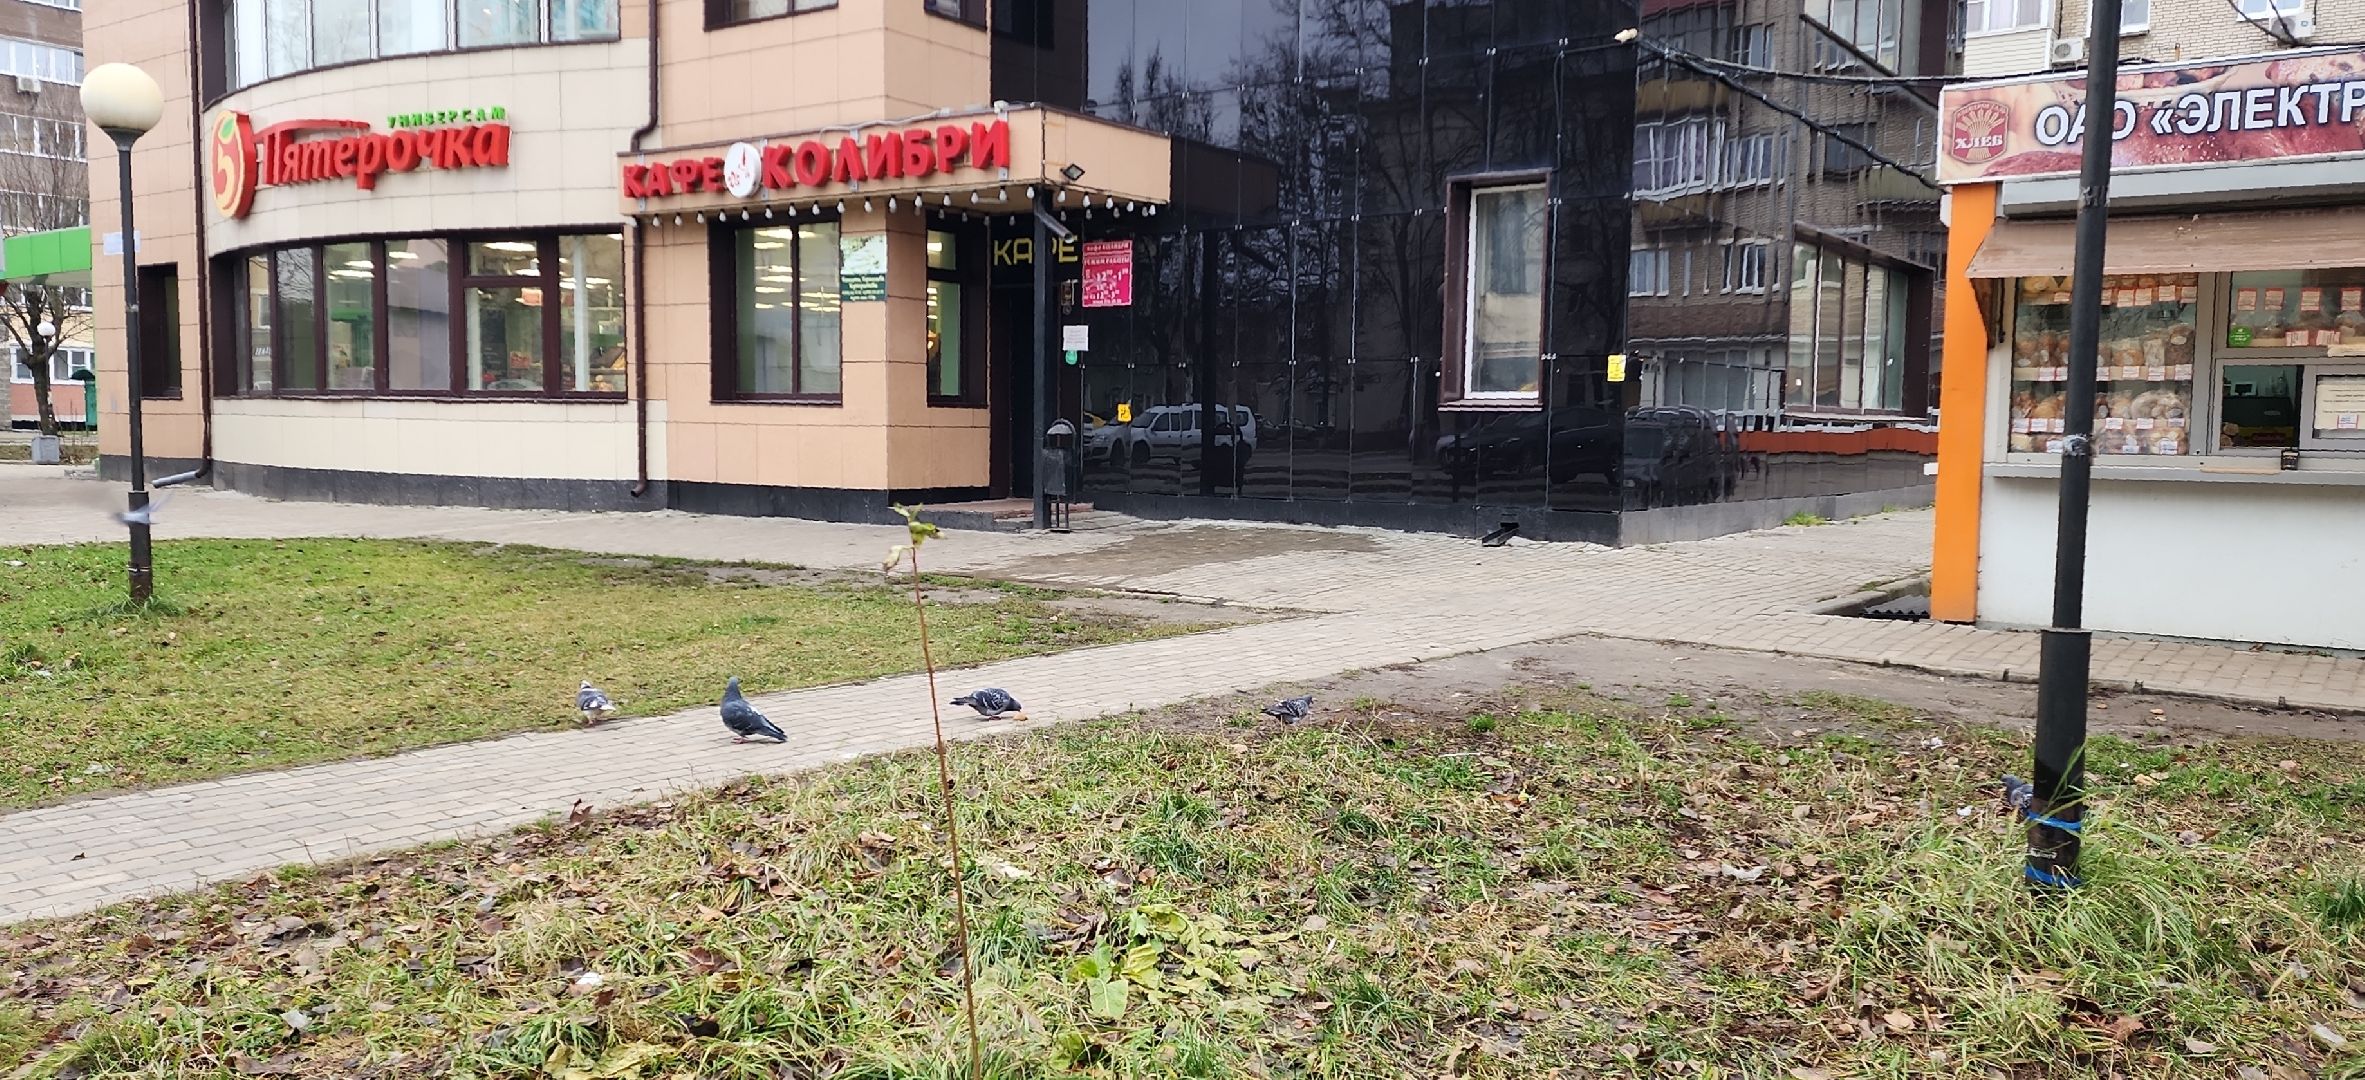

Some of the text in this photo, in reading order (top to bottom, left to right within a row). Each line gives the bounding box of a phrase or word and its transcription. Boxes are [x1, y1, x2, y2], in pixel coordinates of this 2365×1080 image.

[387, 106, 506, 129] УНИВЕРСАМ
[255, 119, 511, 190] Пятерочка
[1954, 134, 2003, 150] ХЛЕБ
[623, 120, 1010, 198] КАФЕ КОЛИБРИ
[994, 235, 1078, 266] КАЕ
